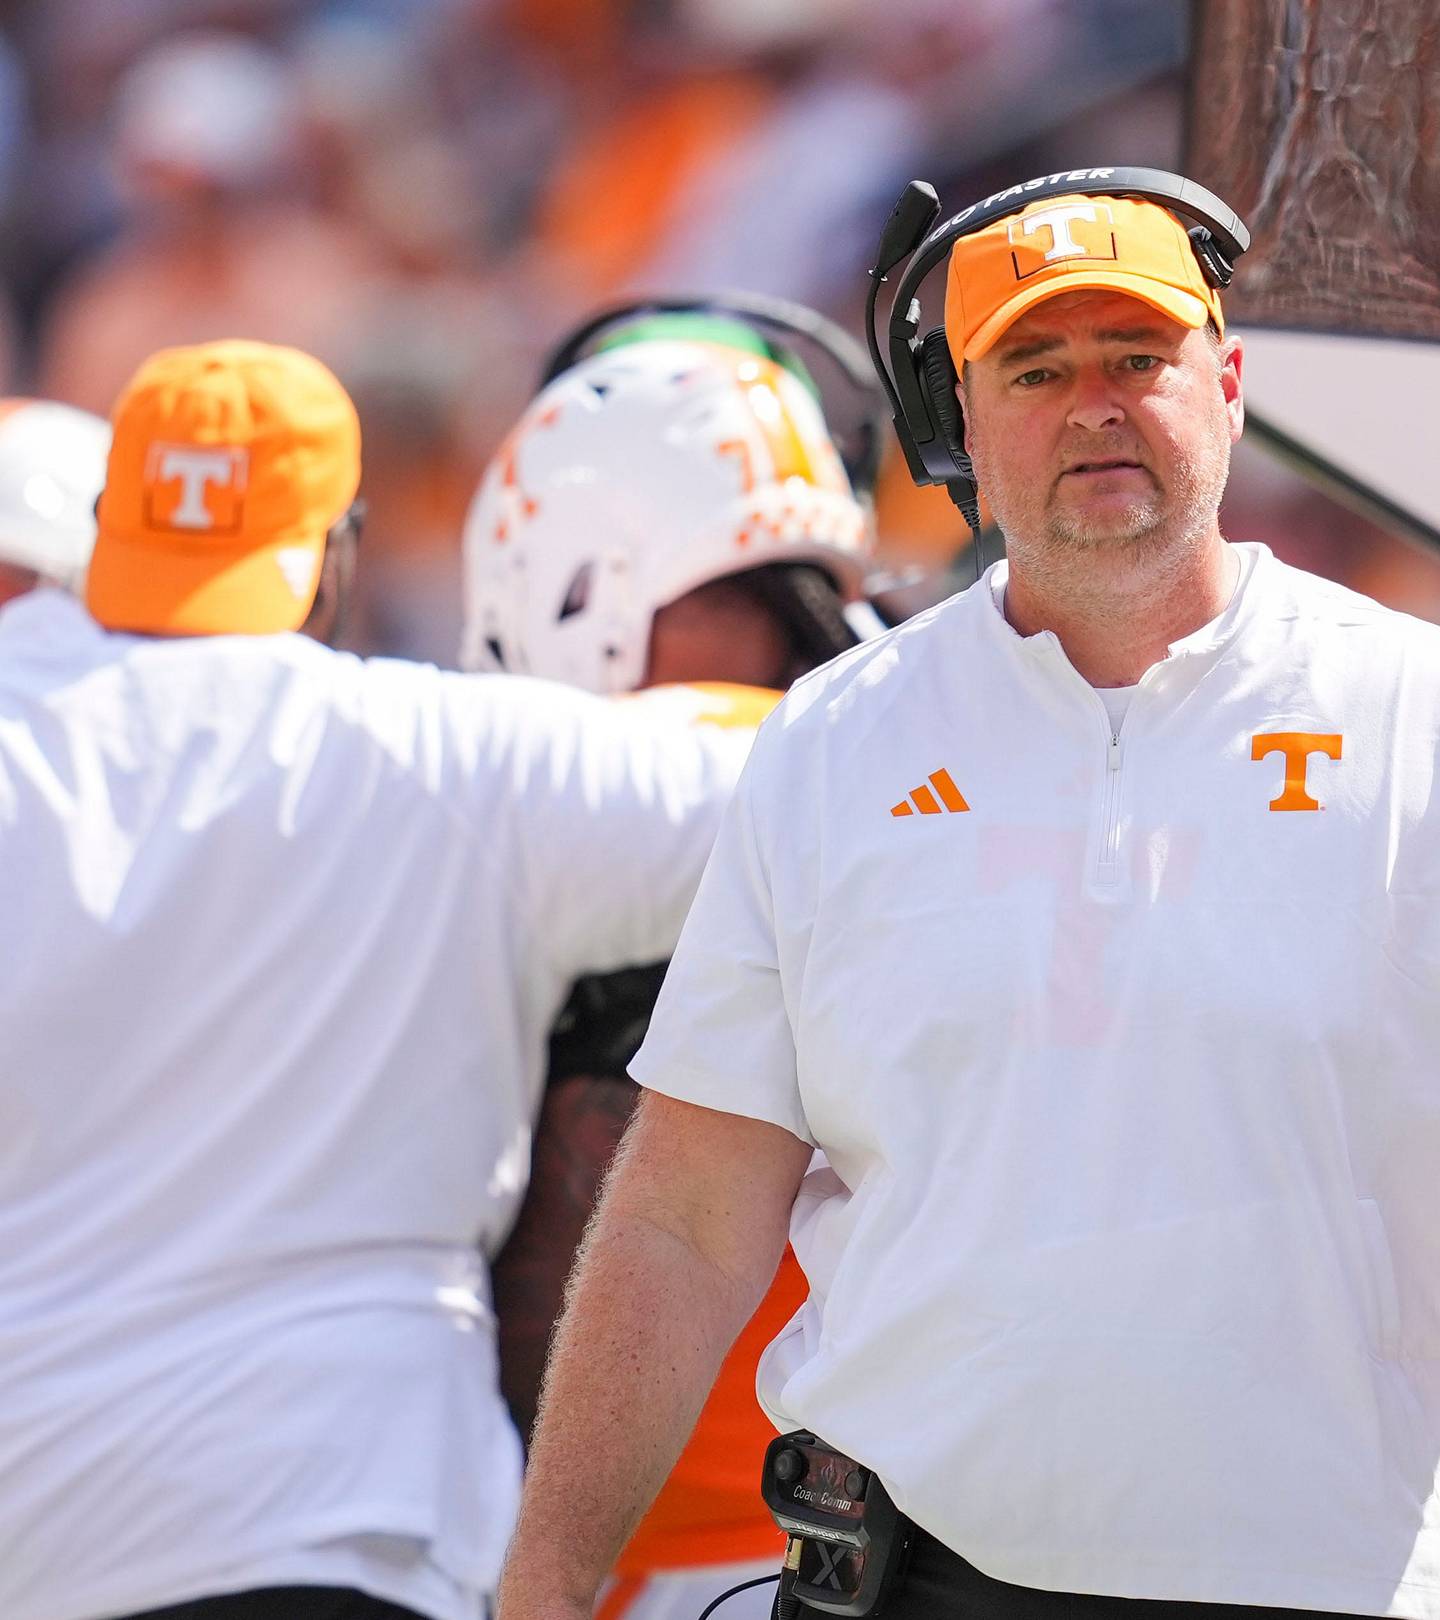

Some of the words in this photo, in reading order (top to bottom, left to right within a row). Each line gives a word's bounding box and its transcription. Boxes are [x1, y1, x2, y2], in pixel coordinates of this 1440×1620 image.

[930, 205, 978, 243] GO
[982, 167, 1115, 209] FASTER
[1022, 205, 1098, 262] T
[158, 452, 232, 529] T
[1250, 732, 1343, 812] T
[793, 1484, 820, 1502] Coac
